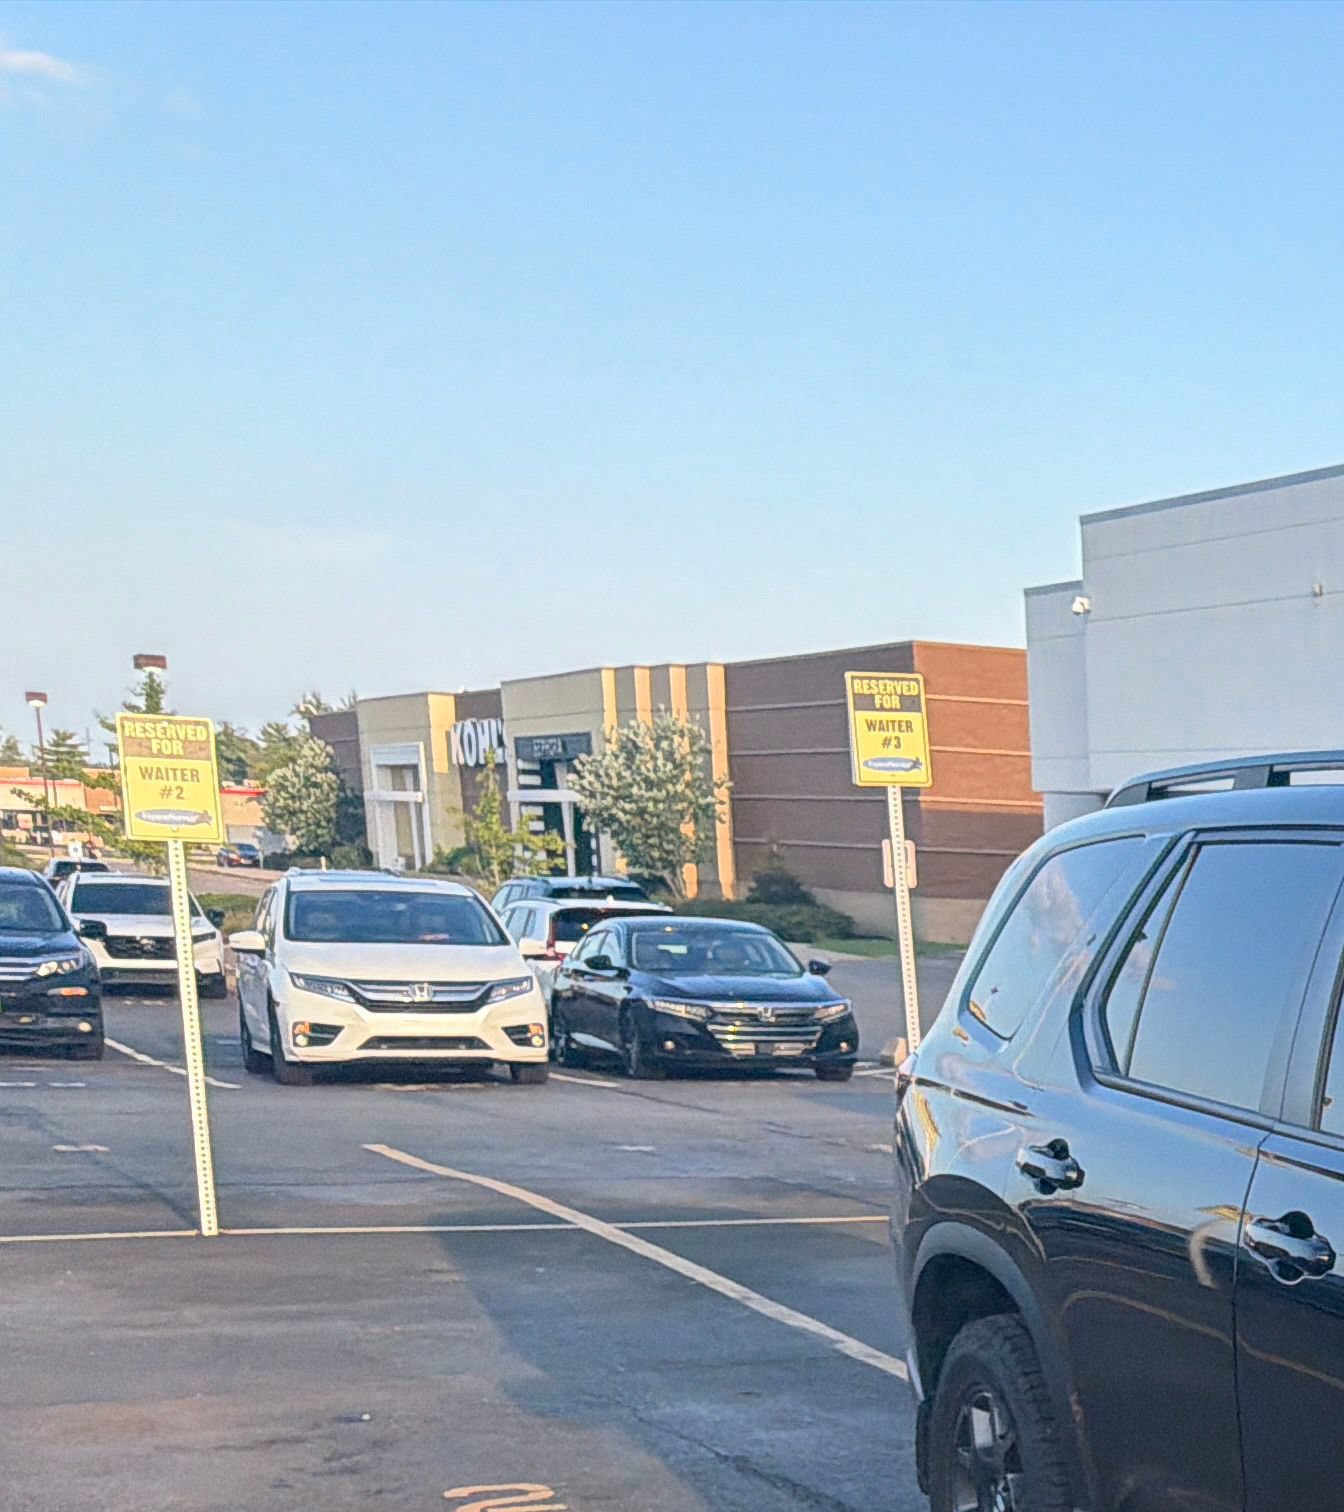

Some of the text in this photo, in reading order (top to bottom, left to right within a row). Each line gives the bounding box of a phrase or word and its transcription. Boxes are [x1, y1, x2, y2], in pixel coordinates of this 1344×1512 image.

[853, 679, 919, 696] RESERVED
[874, 694, 901, 709] FOR
[123, 720, 208, 741] RESERVED
[865, 719, 914, 733] WAITER
[151, 738, 184, 756] FOR
[881, 735, 902, 750] #3
[139, 765, 201, 783] WAITER
[159, 785, 185, 800] #2
